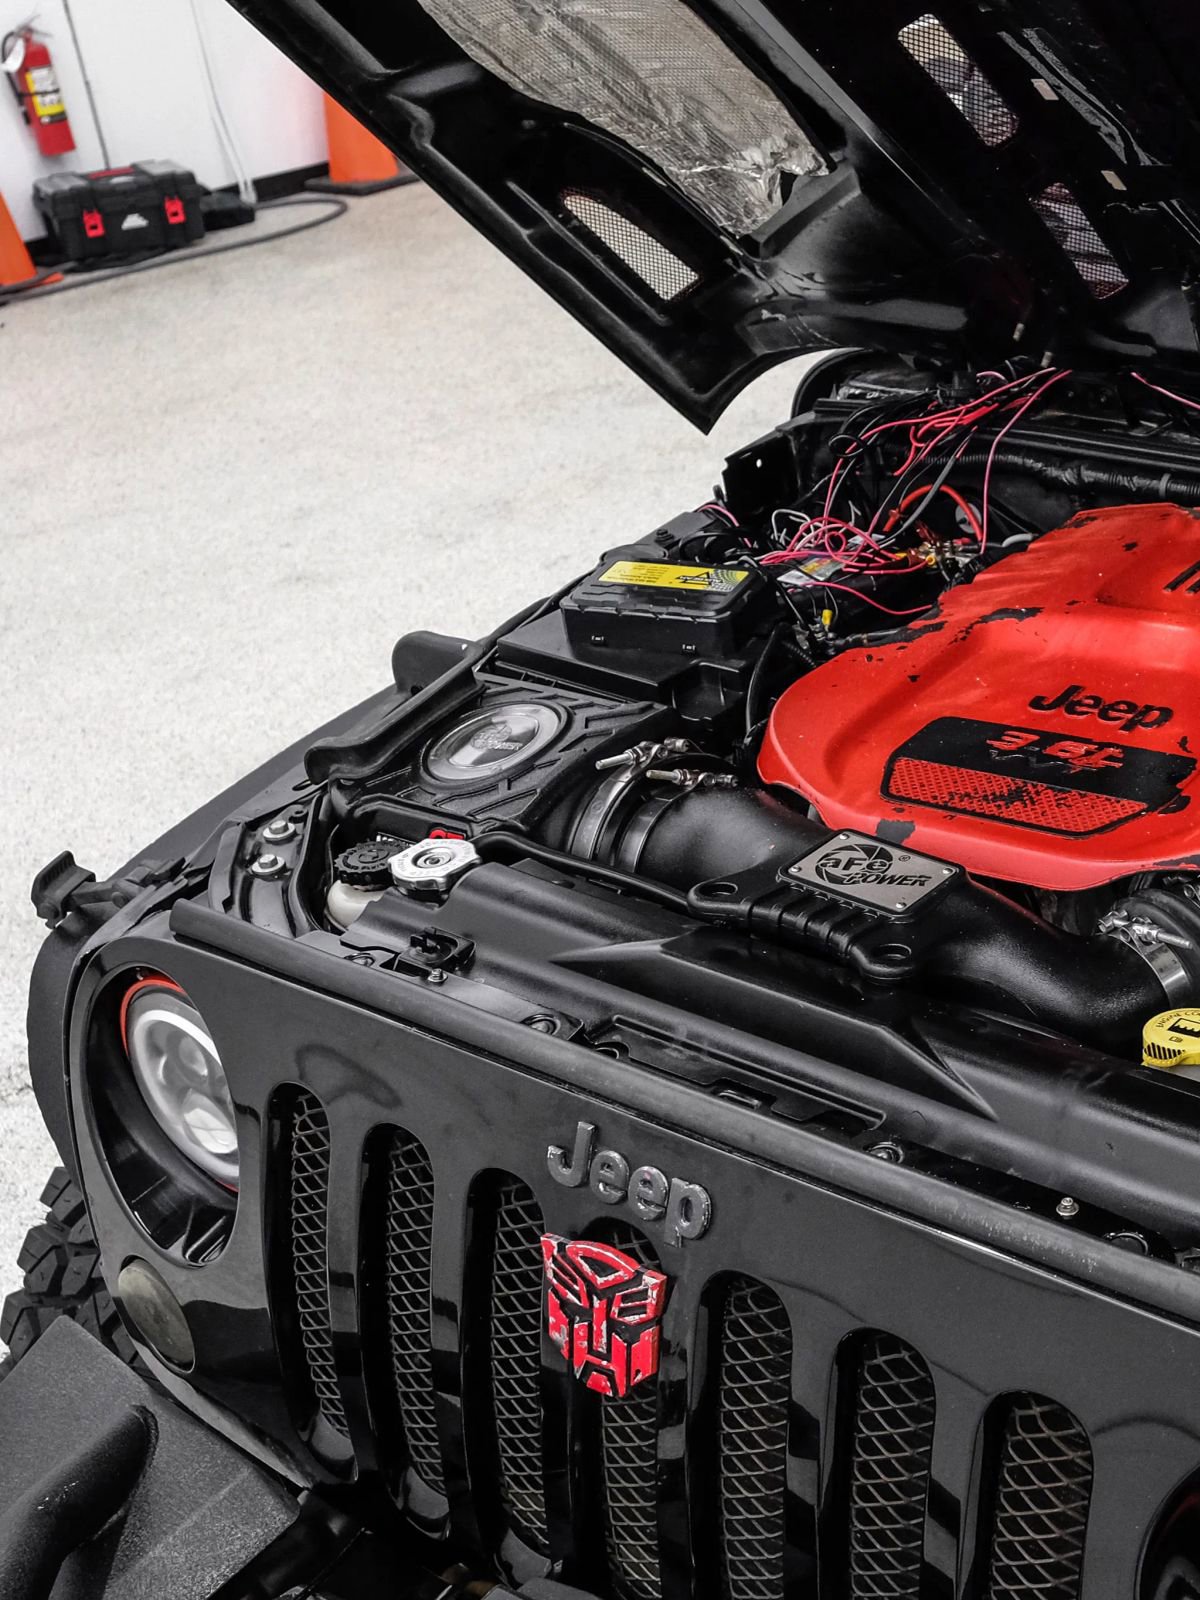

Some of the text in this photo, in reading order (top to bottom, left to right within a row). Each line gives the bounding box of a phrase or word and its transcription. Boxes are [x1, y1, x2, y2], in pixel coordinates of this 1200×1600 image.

[1028, 684, 1174, 732] Jeep
[842, 872, 933, 888] POWER
[546, 1120, 713, 1249] Jeep
